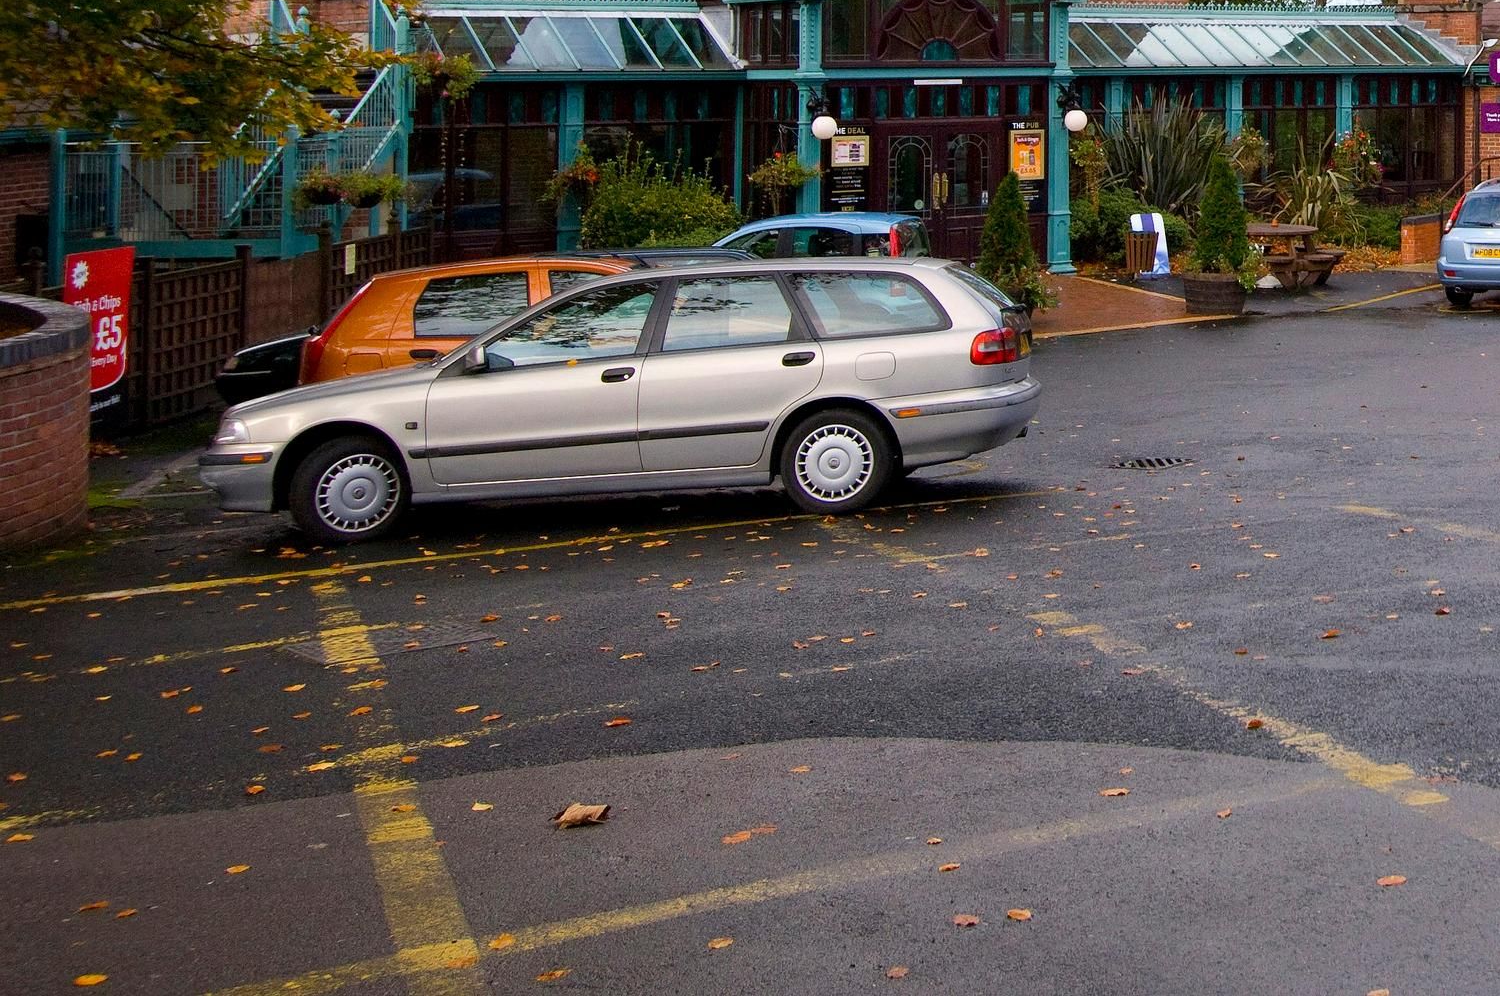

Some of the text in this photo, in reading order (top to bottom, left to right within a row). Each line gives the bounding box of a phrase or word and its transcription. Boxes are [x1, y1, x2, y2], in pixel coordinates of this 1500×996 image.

[834, 126, 866, 135] HE DEAL
[92, 300, 98, 312] &
[99, 294, 122, 313] Chips
[96, 314, 123, 351] £5
